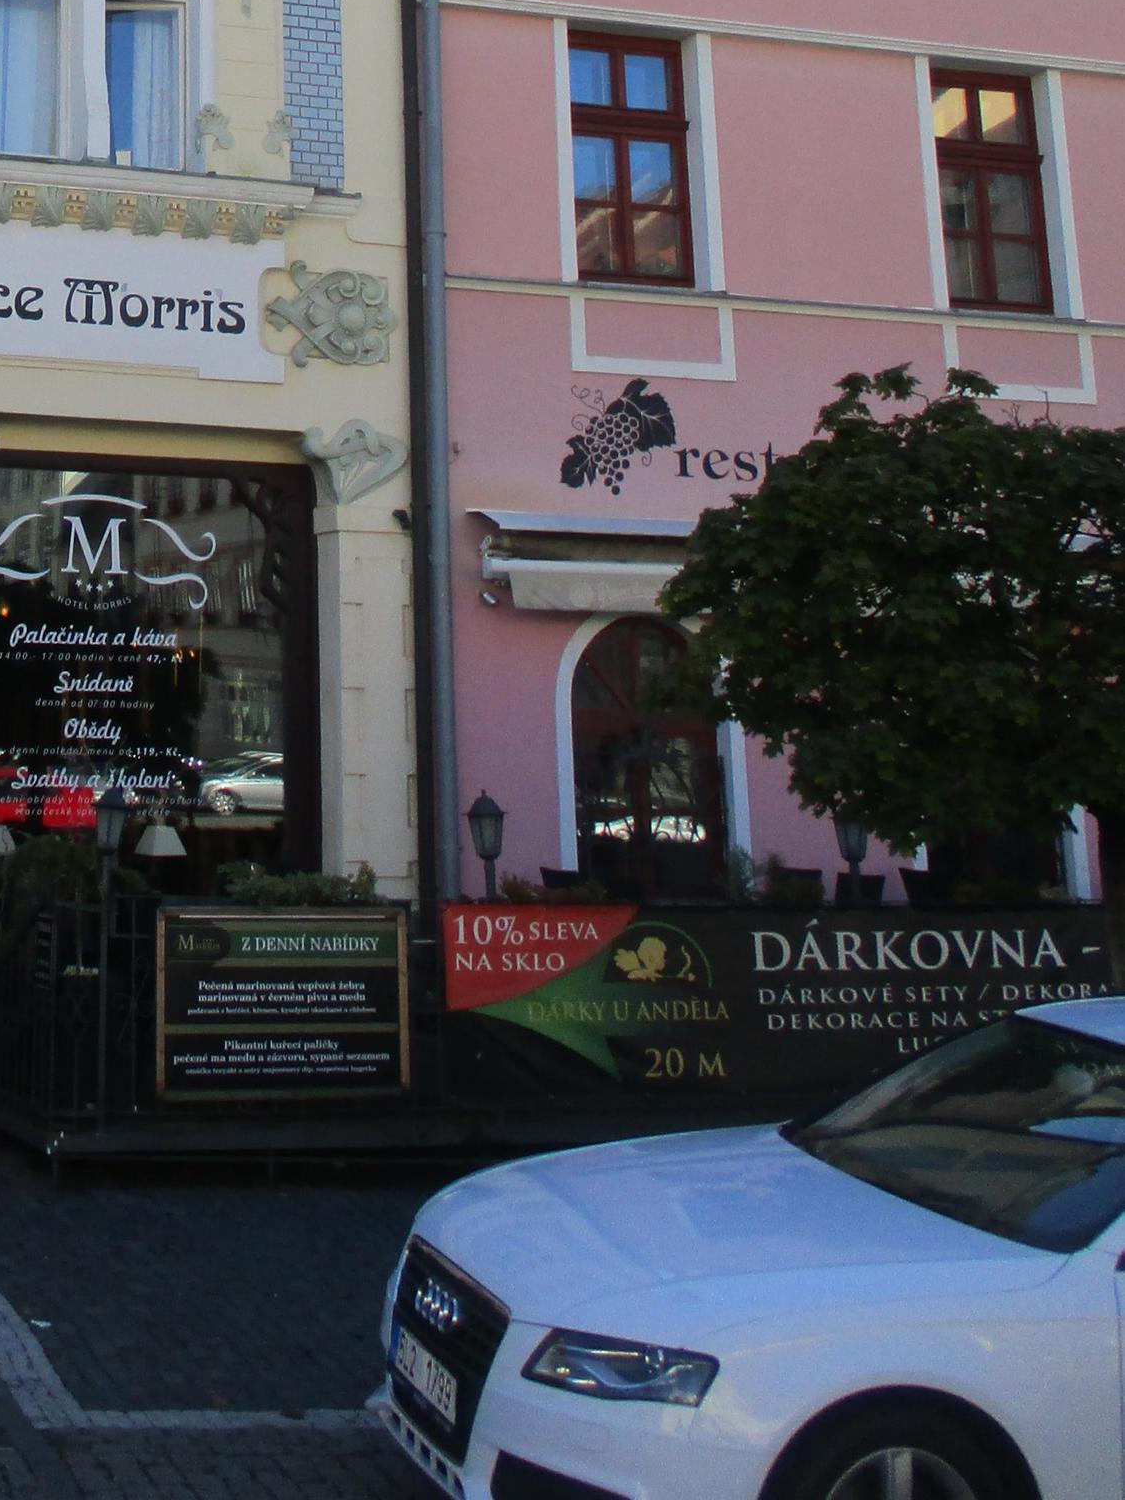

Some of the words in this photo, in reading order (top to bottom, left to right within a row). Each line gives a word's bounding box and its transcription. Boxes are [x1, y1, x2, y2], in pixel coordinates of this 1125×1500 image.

[63, 277, 247, 335] Morris
[61, 515, 127, 575] M
[57, 595, 89, 611] HOTEL
[93, 595, 132, 611] MORRIS
[9, 622, 108, 648] Palačinka
[111, 631, 126, 646] a
[130, 625, 178, 648] káva
[75, 653, 104, 662] hodin
[53, 671, 134, 694] Snídaně
[35, 698, 67, 707] denně
[70, 700, 83, 709] od
[120, 700, 155, 710] hodiny
[64, 718, 122, 745] Obědy
[9, 746, 40, 756] denní
[11, 766, 80, 794] Svatby
[85, 774, 101, 788] a
[453, 915, 524, 946] 10%
[529, 921, 598, 941] SLEVA
[241, 937, 251, 951] Z
[255, 933, 306, 951] DENNÍ
[310, 933, 379, 951] NABÍDKY
[751, 918, 1067, 972] DÁRKOVNA
[455, 952, 492, 971] NA
[502, 952, 565, 971] SKLO
[198, 980, 234, 991] Pečená
[236, 980, 295, 990] marinovaná
[339, 980, 365, 990] žebra
[758, 983, 894, 1005] DÁRKOVÉ
[905, 985, 969, 1002] SETY
[1002, 982, 1115, 1000] DEKORA
[198, 991, 258, 1002] marinovaná
[260, 994, 266, 1002] v
[268, 991, 304, 1002] černém
[306, 991, 328, 1004] pivu
[339, 991, 366, 1001] medu
[527, 998, 605, 1022] DÁRKY
[614, 1002, 629, 1021] U
[636, 996, 729, 1021] ANDĚLA
[767, 1011, 920, 1030] DEKORACE
[931, 1010, 968, 1027] NA
[224, 1040, 268, 1050] Pikantní
[173, 1053, 208, 1066] pečené
[228, 1052, 256, 1062] medu
[645, 1048, 685, 1077] 20
[698, 1051, 727, 1077] M
